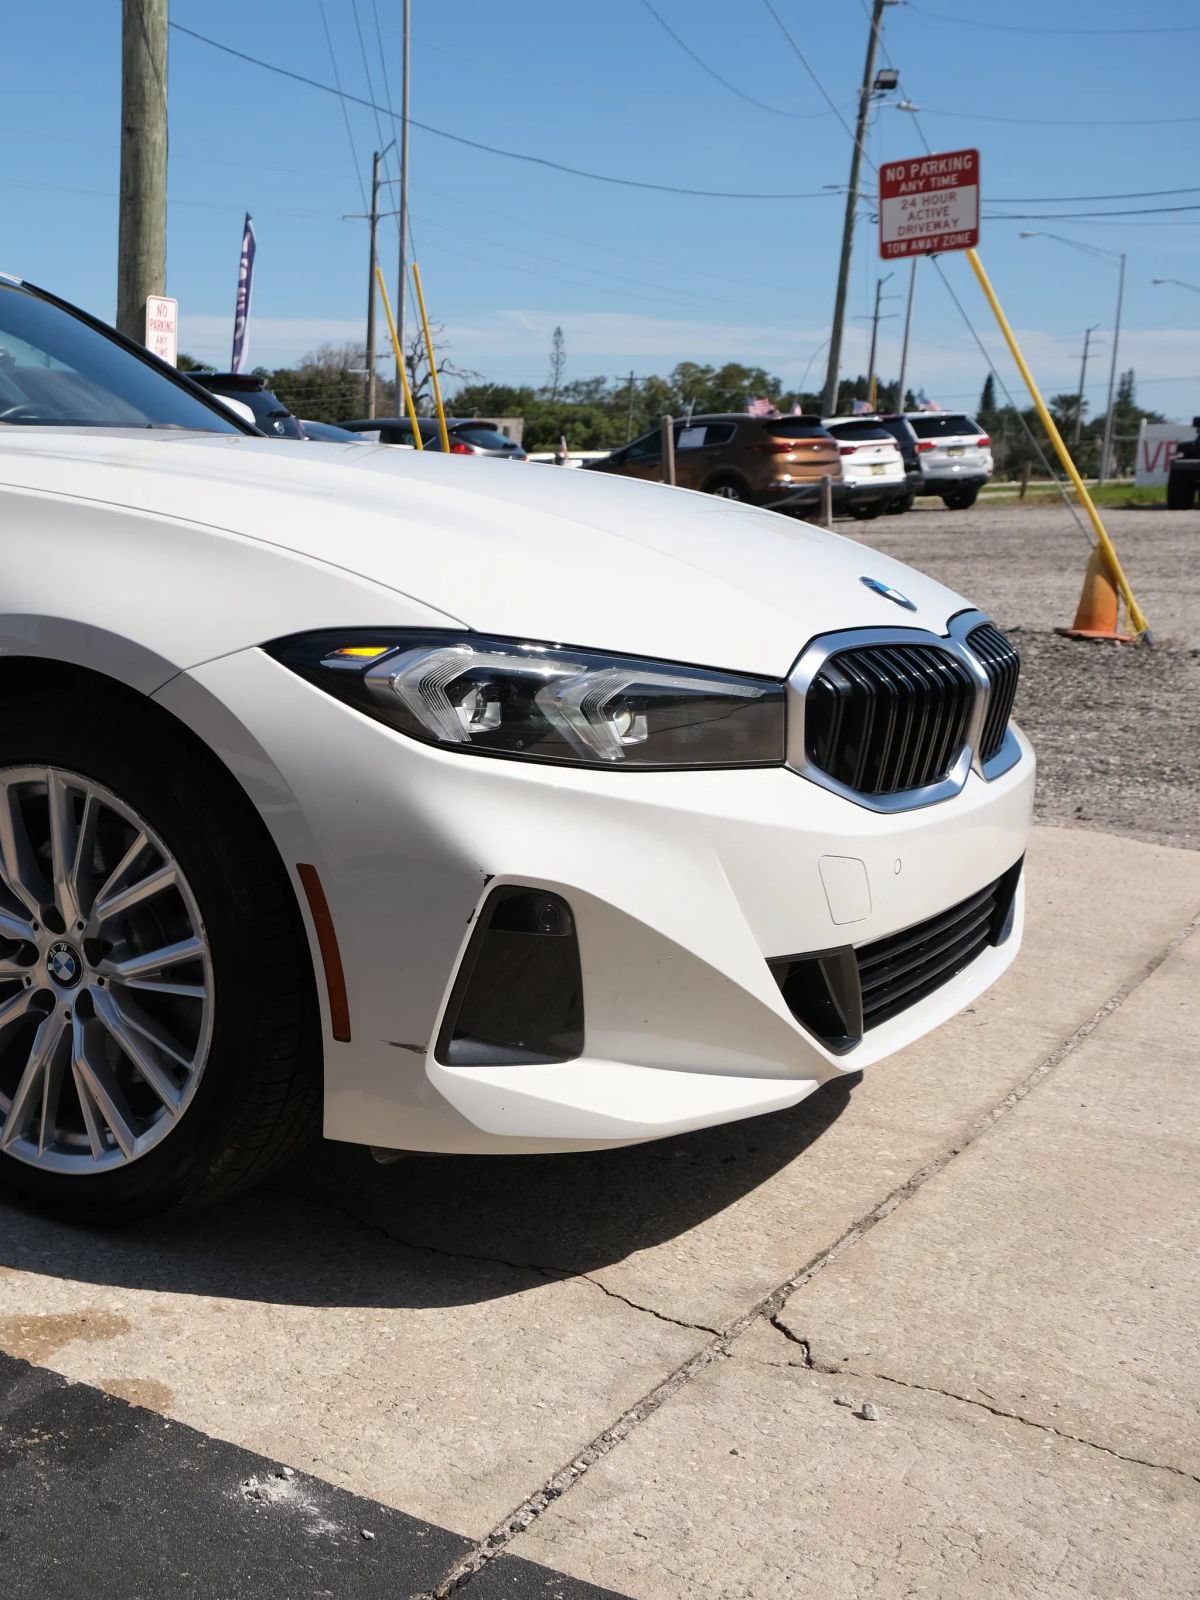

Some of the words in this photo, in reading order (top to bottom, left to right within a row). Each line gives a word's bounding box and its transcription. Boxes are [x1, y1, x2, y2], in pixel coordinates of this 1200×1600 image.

[886, 166, 905, 182] NO
[910, 155, 973, 178] PARKING
[899, 179, 927, 194] ANY
[930, 173, 959, 188] TIME
[901, 198, 917, 210] 24
[922, 191, 957, 207] HOUR
[908, 206, 951, 221] ACTIVE
[897, 218, 959, 236] DRIVEWAY
[886, 241, 908, 254] TOW
[911, 237, 940, 250] AWAY
[942, 232, 971, 247] ZONE
[157, 304, 167, 317] NO
[149, 318, 174, 334] PARKING
